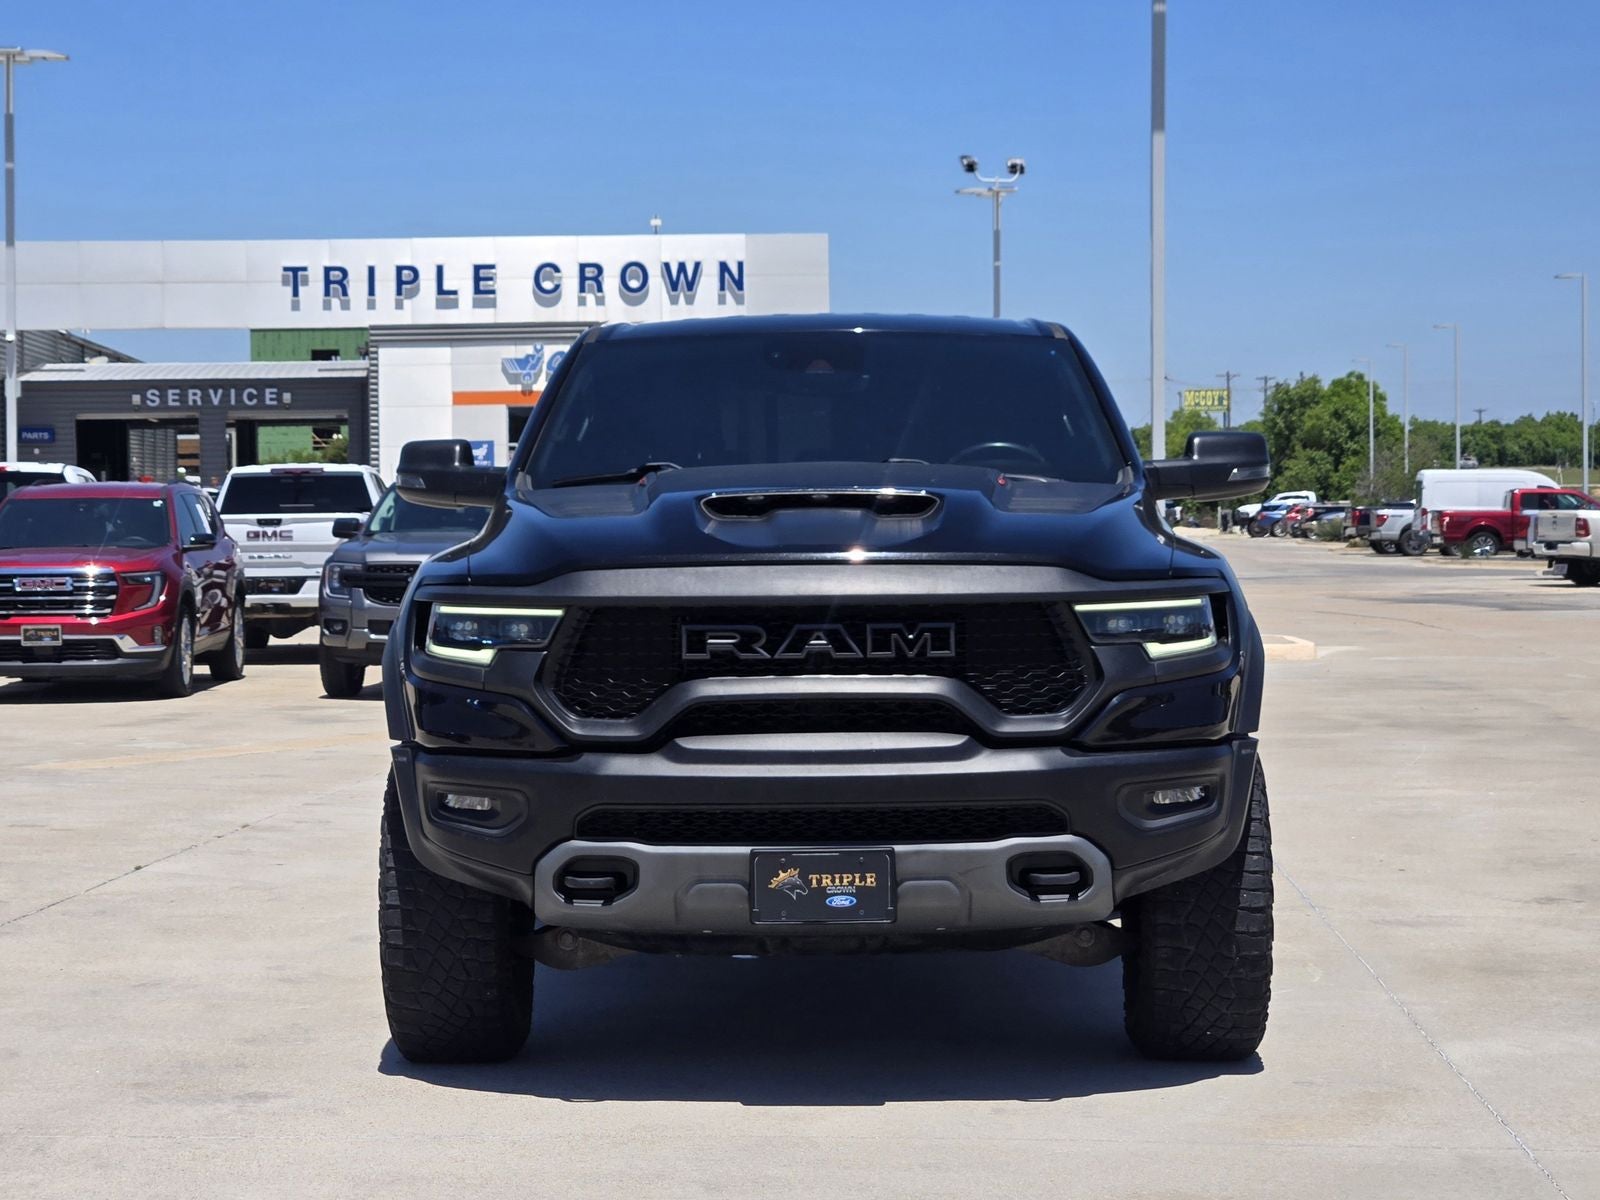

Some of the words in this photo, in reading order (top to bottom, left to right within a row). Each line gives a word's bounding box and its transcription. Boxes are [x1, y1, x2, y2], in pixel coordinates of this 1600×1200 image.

[281, 264, 497, 299] TRIPLE
[533, 260, 745, 296] CROWN
[145, 388, 278, 406] SERVICE
[21, 431, 49, 440] PARTS
[246, 529, 293, 541] GMC
[14, 577, 73, 592] GMC
[681, 623, 956, 659] RAM
[808, 872, 877, 888] TRIPLE
[831, 897, 851, 906] Ford
